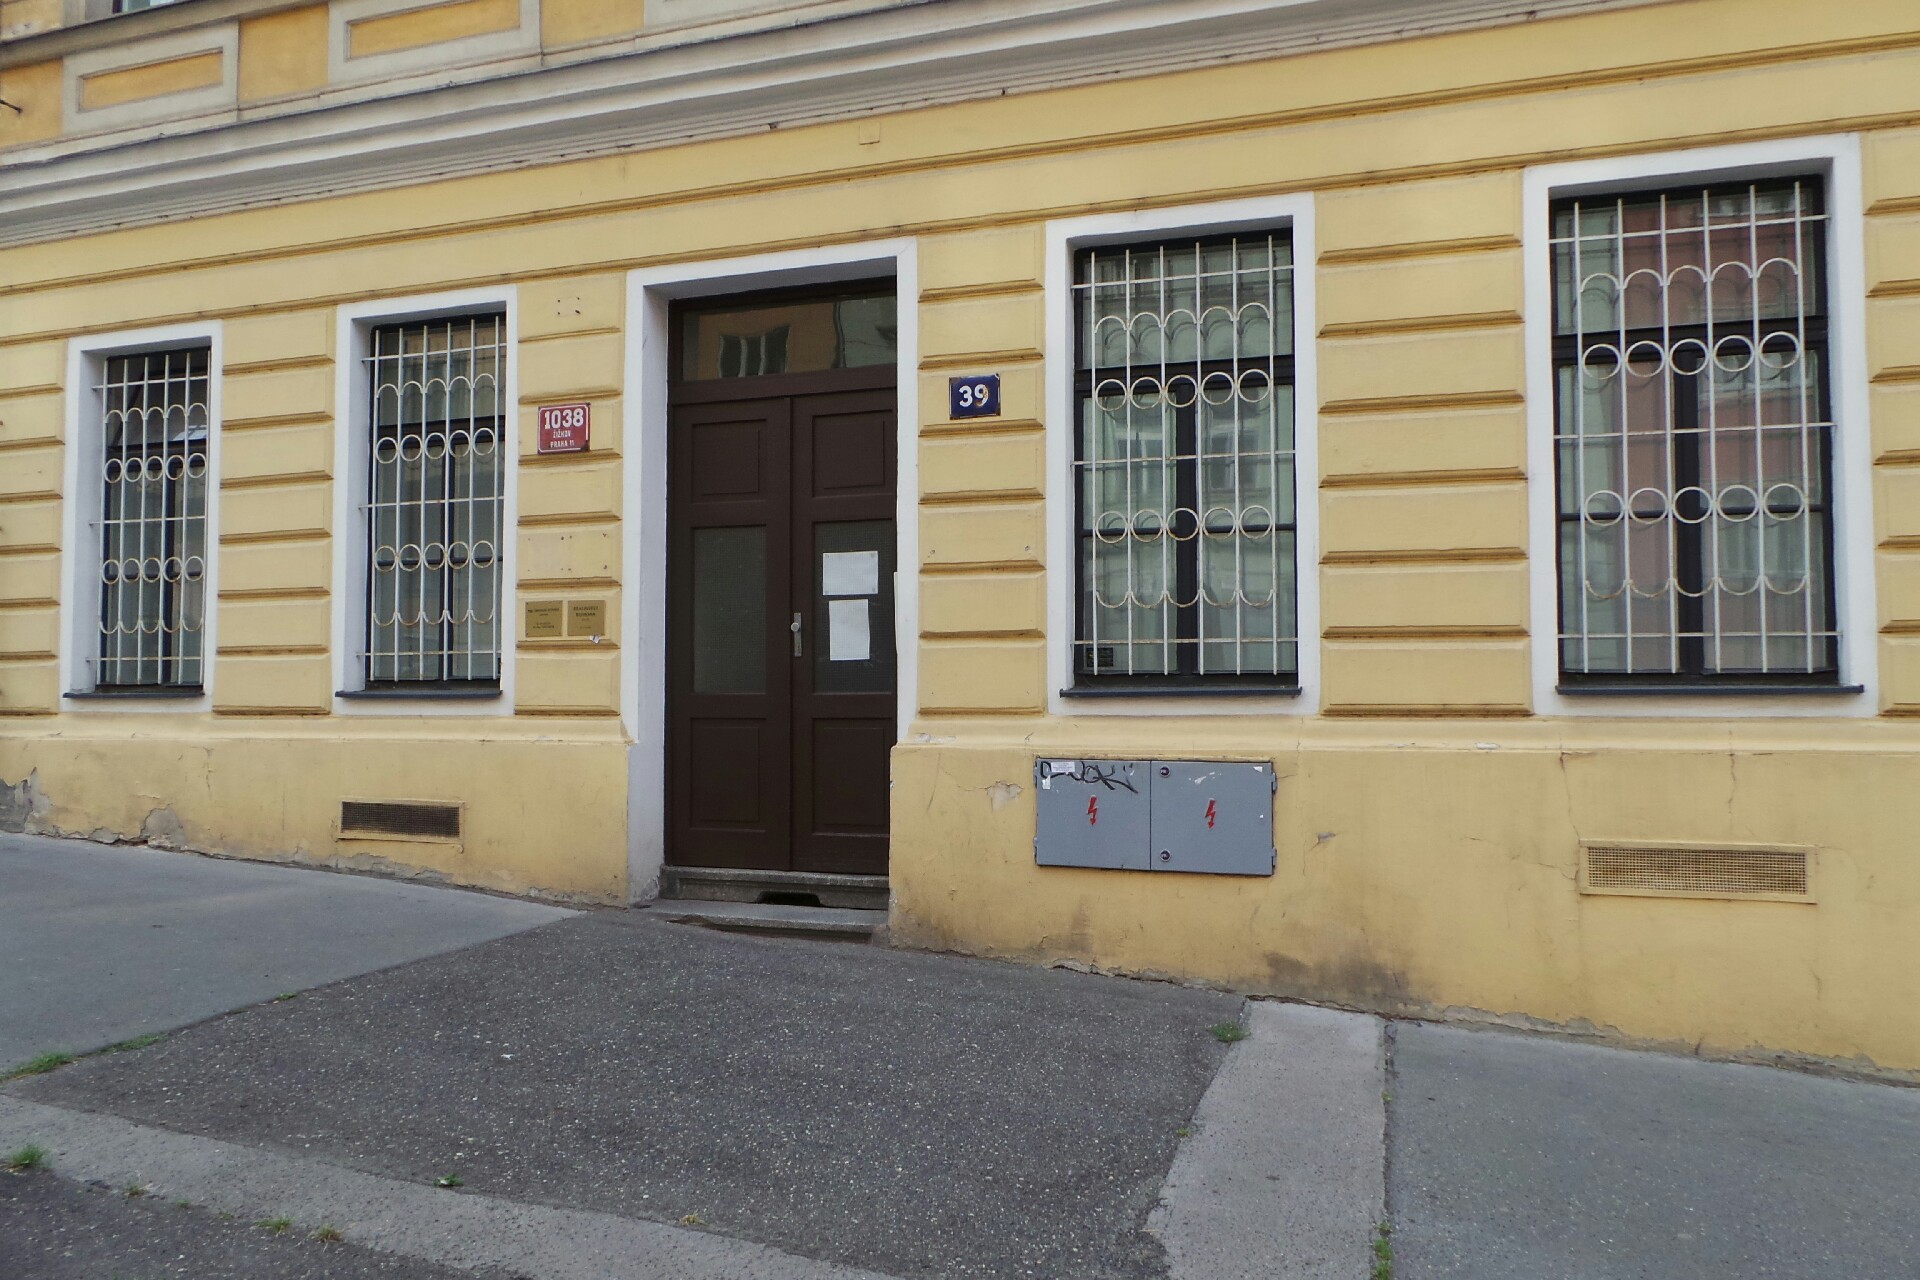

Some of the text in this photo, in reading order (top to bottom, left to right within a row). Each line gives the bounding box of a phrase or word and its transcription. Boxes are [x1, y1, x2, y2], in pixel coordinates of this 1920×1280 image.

[958, 384, 989, 408] 39
[545, 408, 583, 429] 1038
[550, 440, 568, 448] PRAHA
